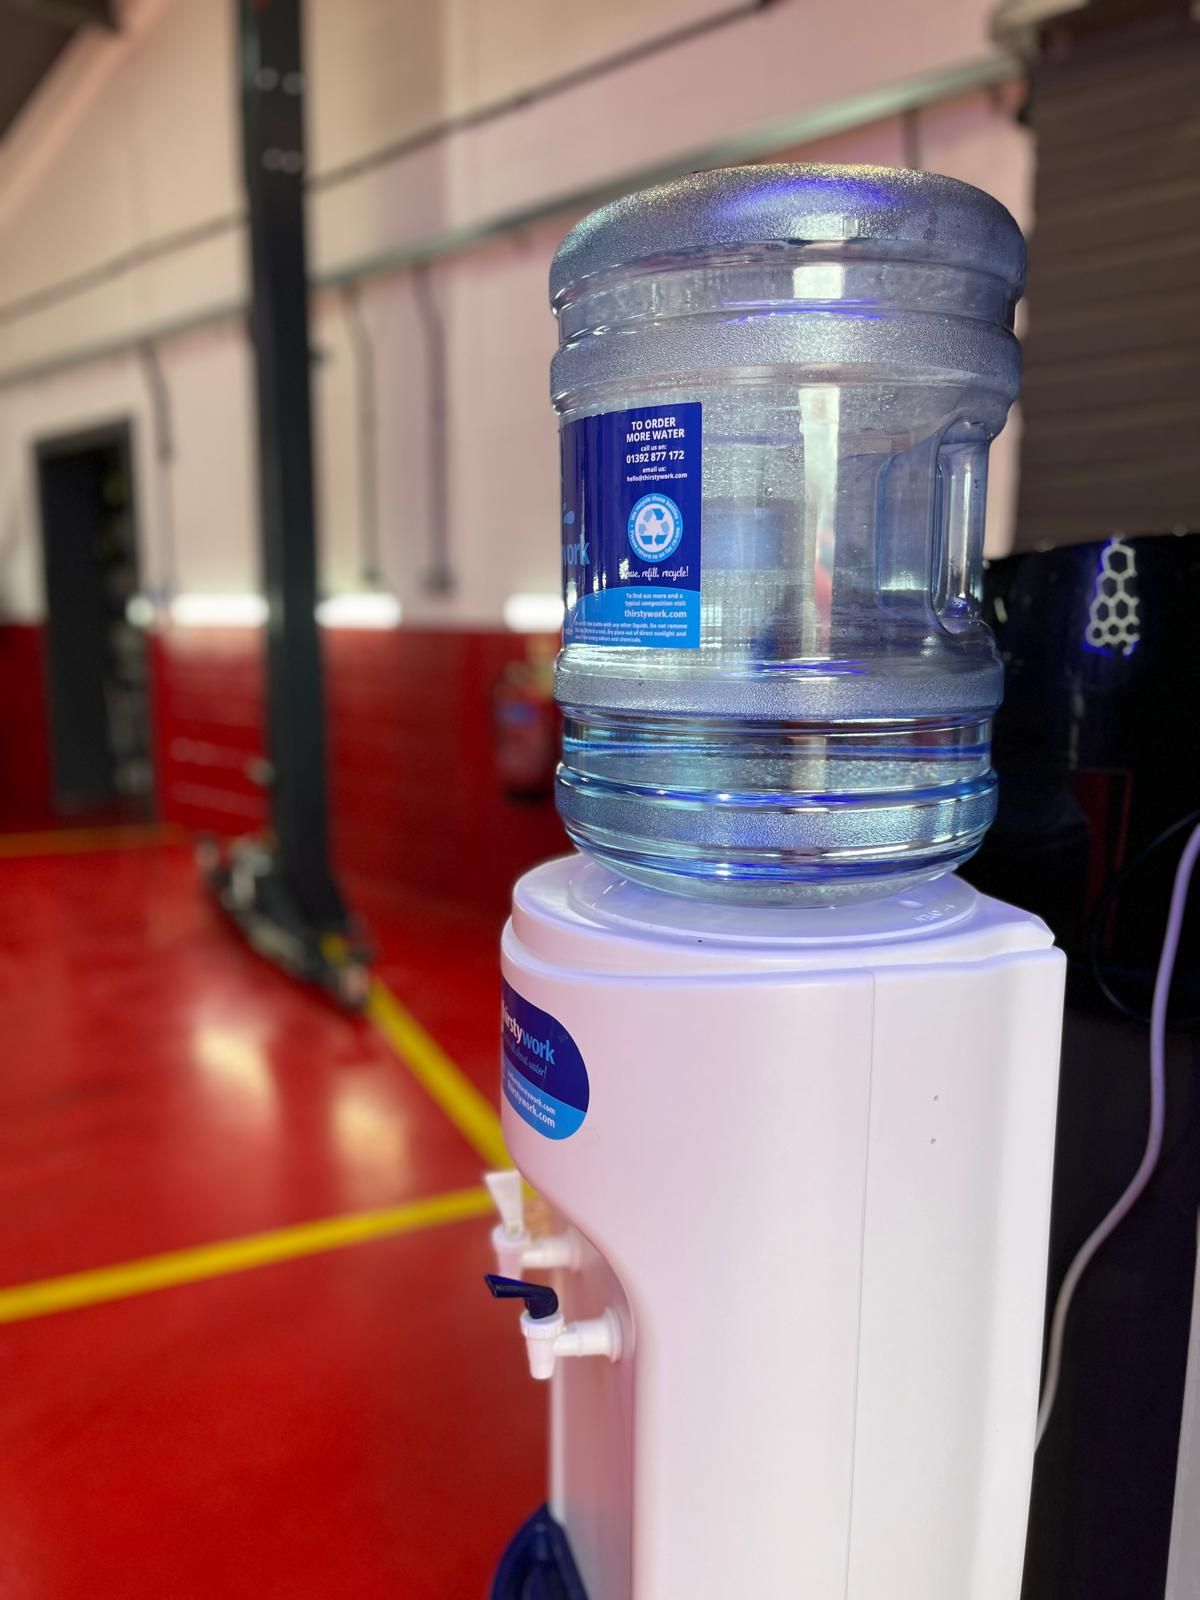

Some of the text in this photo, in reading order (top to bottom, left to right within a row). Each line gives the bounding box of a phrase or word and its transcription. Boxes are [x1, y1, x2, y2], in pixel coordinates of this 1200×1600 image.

[631, 417, 676, 431] TO ORDER
[626, 428, 685, 443] MORE WATER
[626, 450, 685, 464] 01392 877 172
[626, 472, 688, 482] hello@thirstywork.com
[624, 609, 687, 620] thirstywork.com
